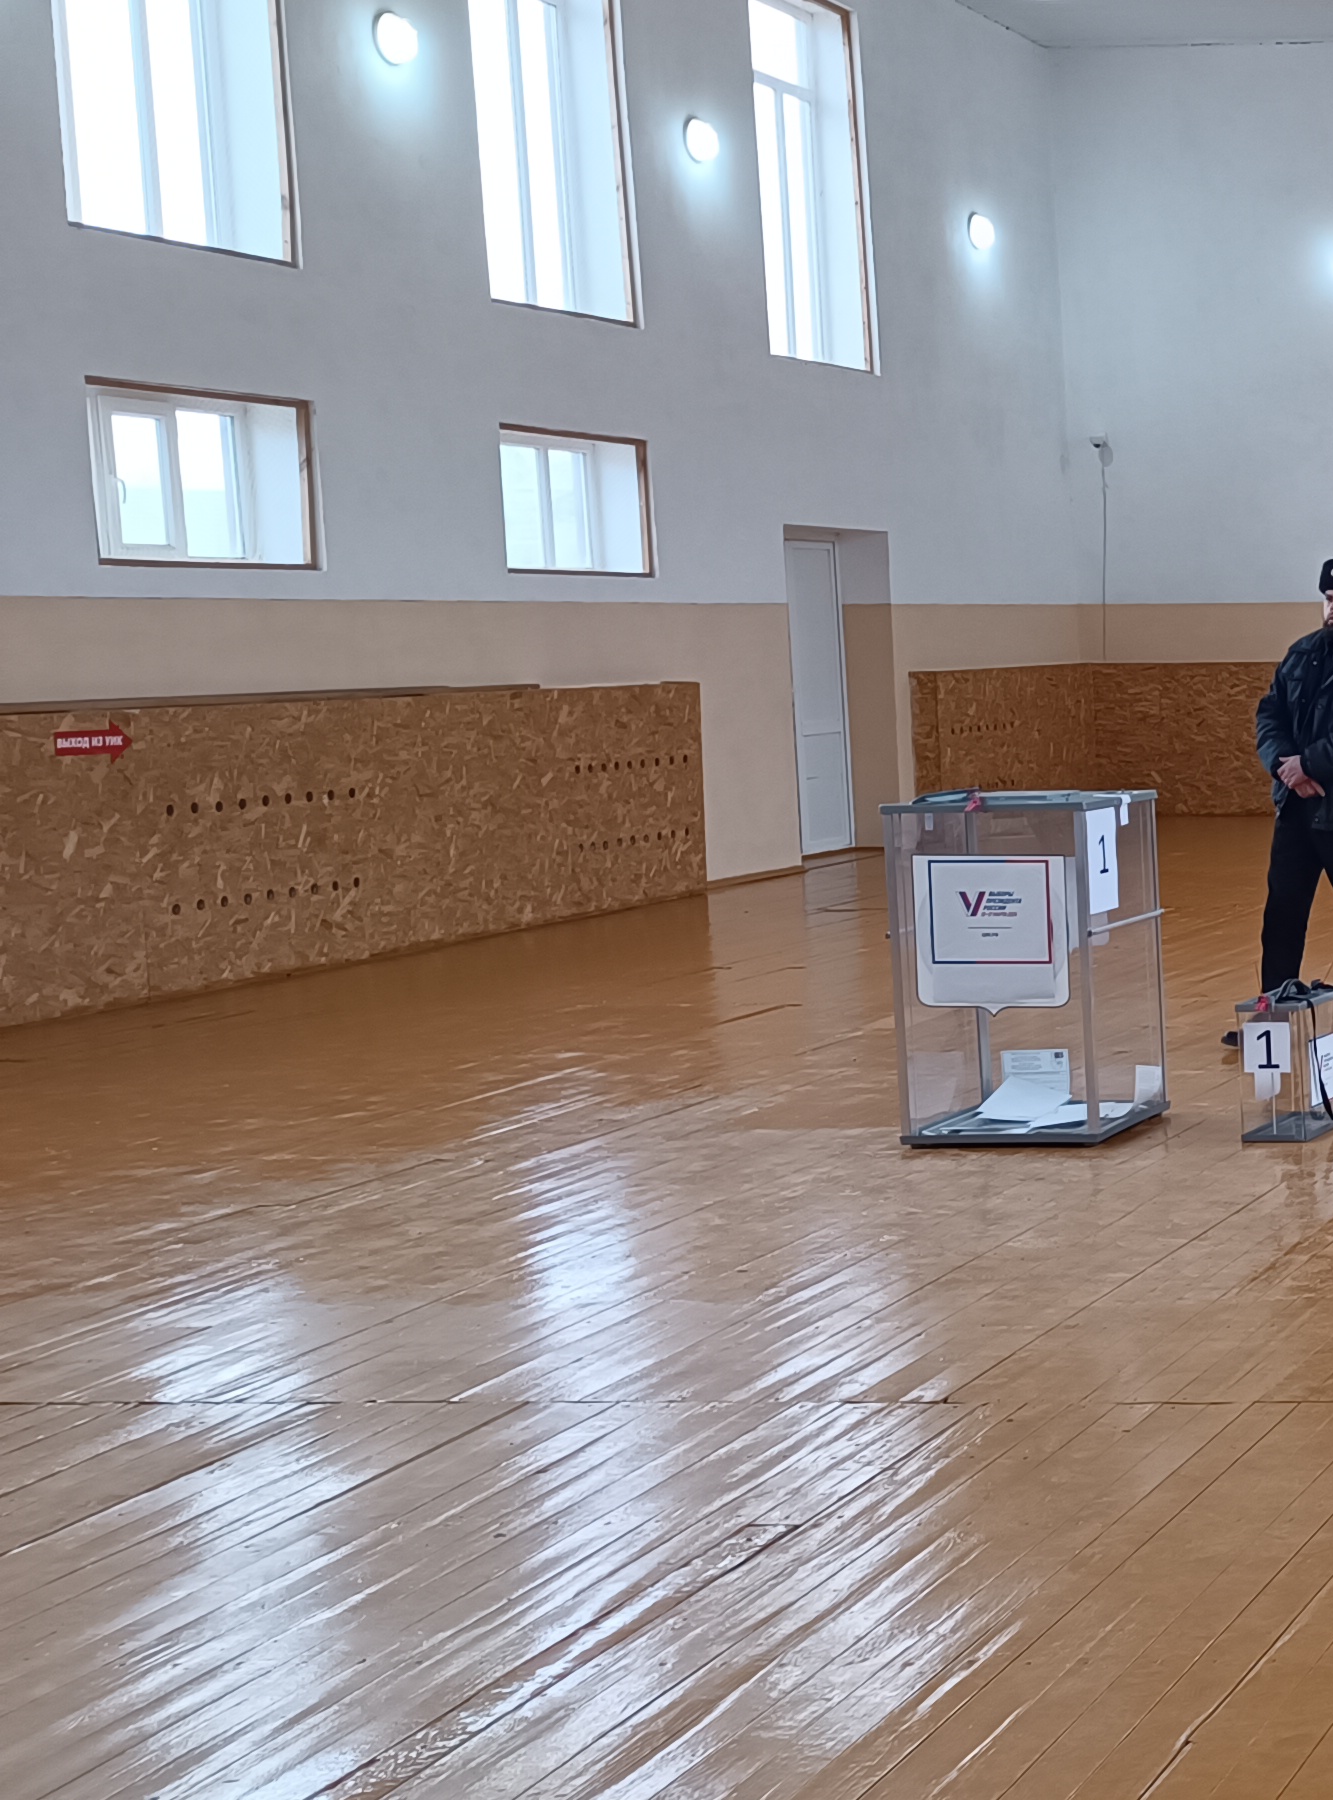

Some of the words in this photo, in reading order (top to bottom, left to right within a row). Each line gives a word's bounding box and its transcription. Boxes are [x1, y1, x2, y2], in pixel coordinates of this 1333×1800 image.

[56, 736, 90, 749] ВЫХОД
[91, 736, 103, 747] ИЗ
[104, 735, 123, 746] УИК
[1098, 834, 1109, 874] 1
[1256, 1029, 1280, 1069] 1
